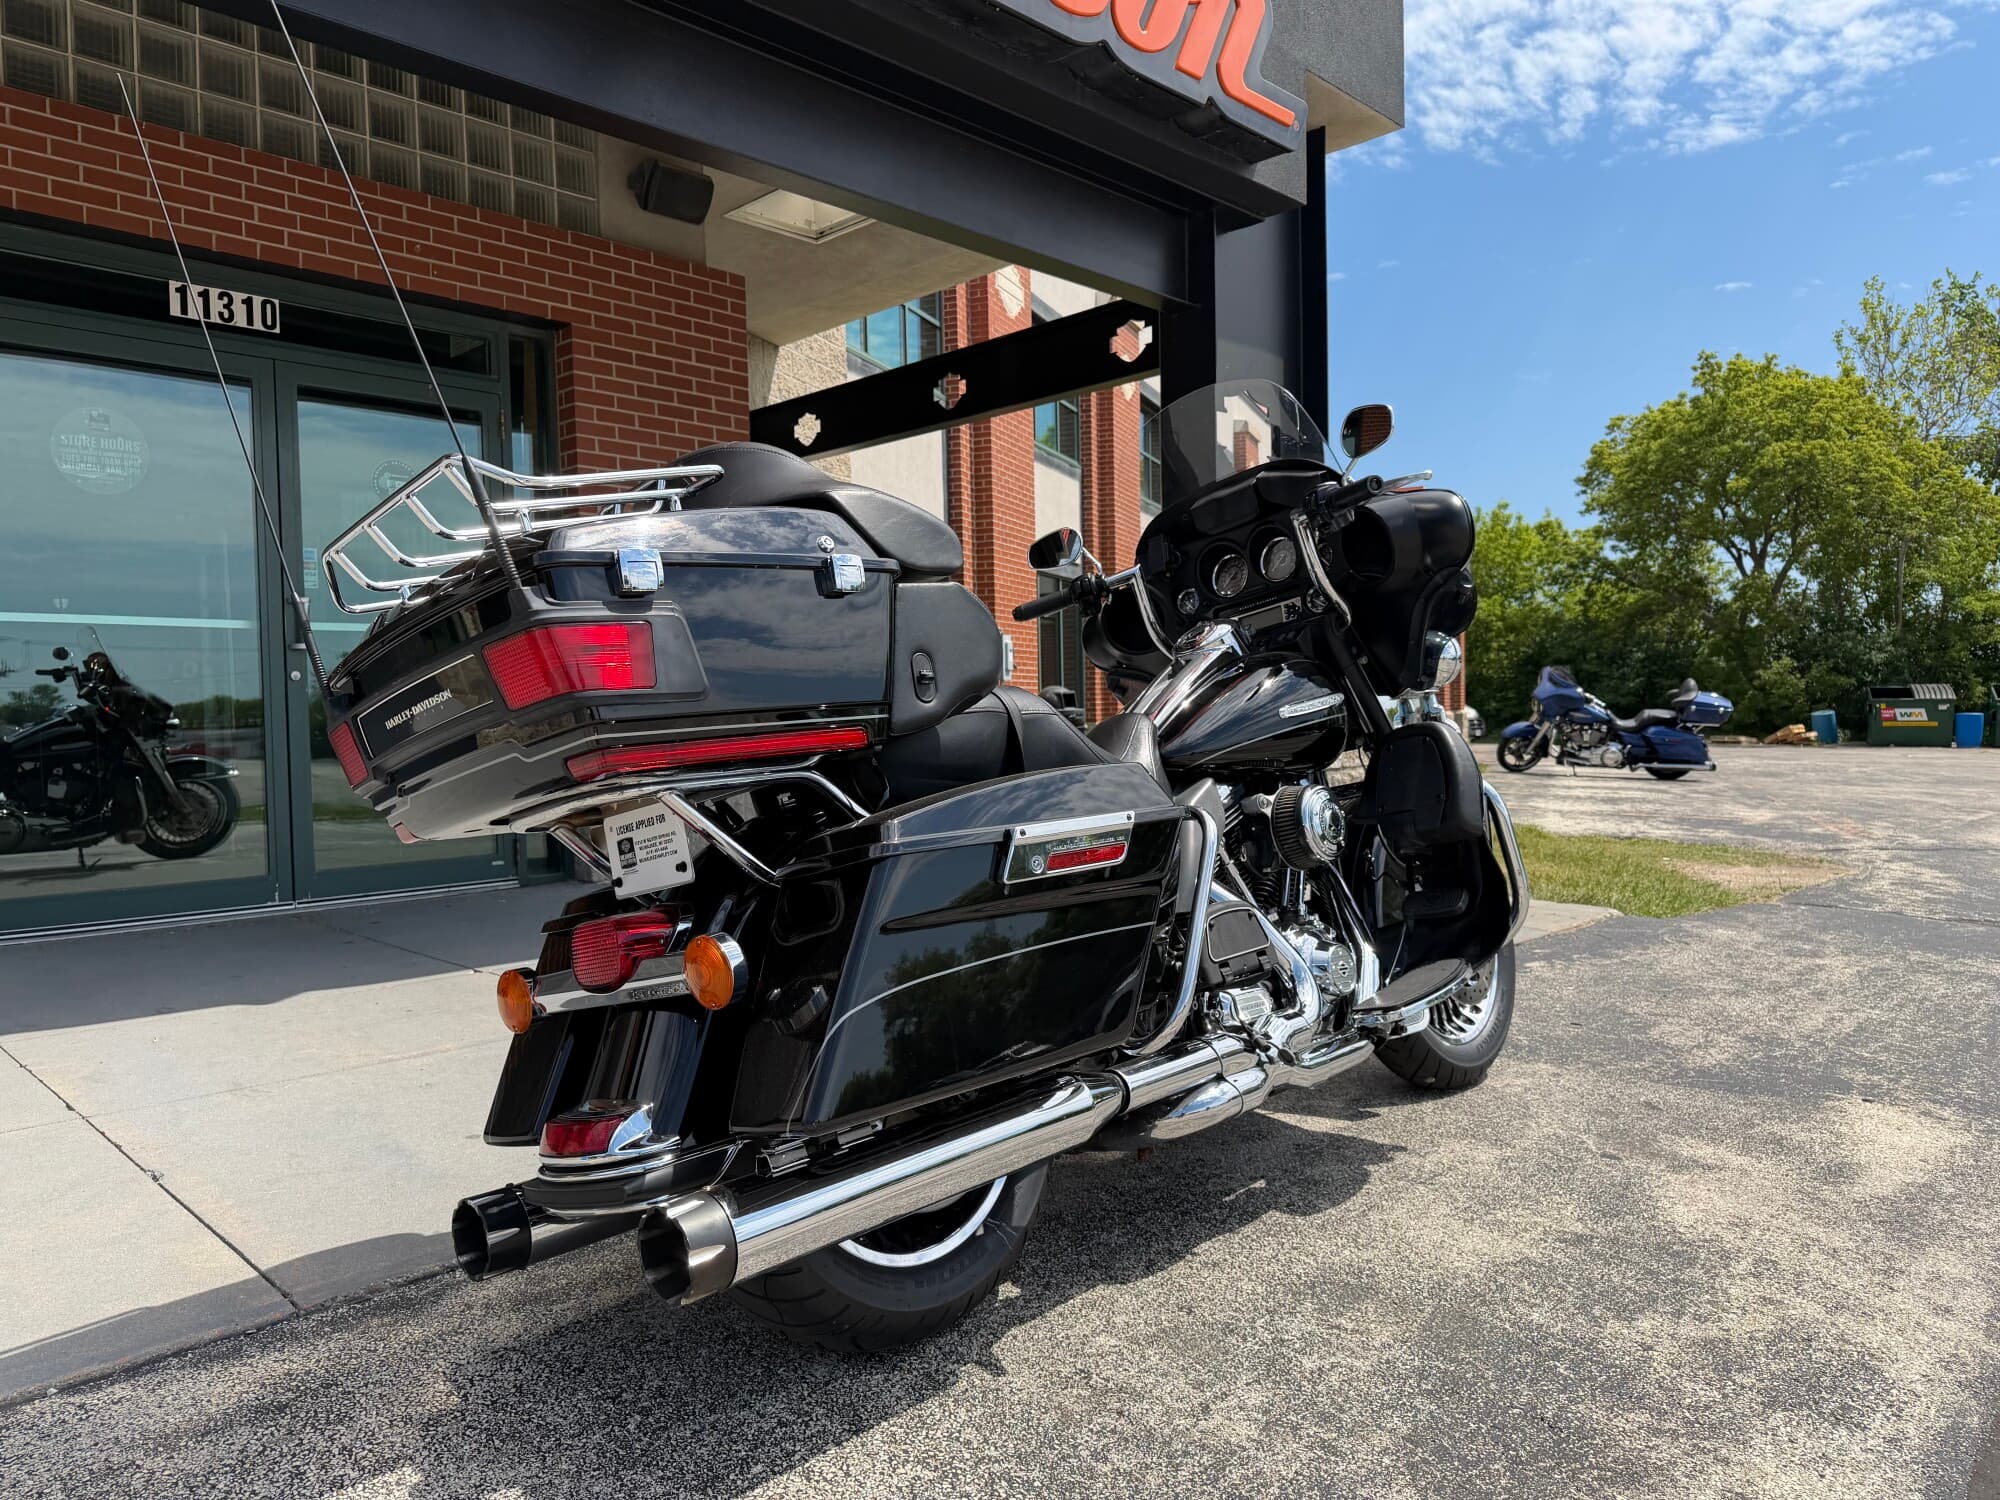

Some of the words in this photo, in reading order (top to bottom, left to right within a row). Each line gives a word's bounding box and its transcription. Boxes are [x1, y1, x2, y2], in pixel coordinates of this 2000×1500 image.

[1050, 0, 1296, 127] on
[175, 284, 277, 331] 11310
[60, 434, 97, 448] STORE
[100, 437, 141, 452] HOURS
[616, 822, 635, 836] LICENSE
[635, 817, 655, 830] APPLIED
[656, 813, 666, 825] FOR
